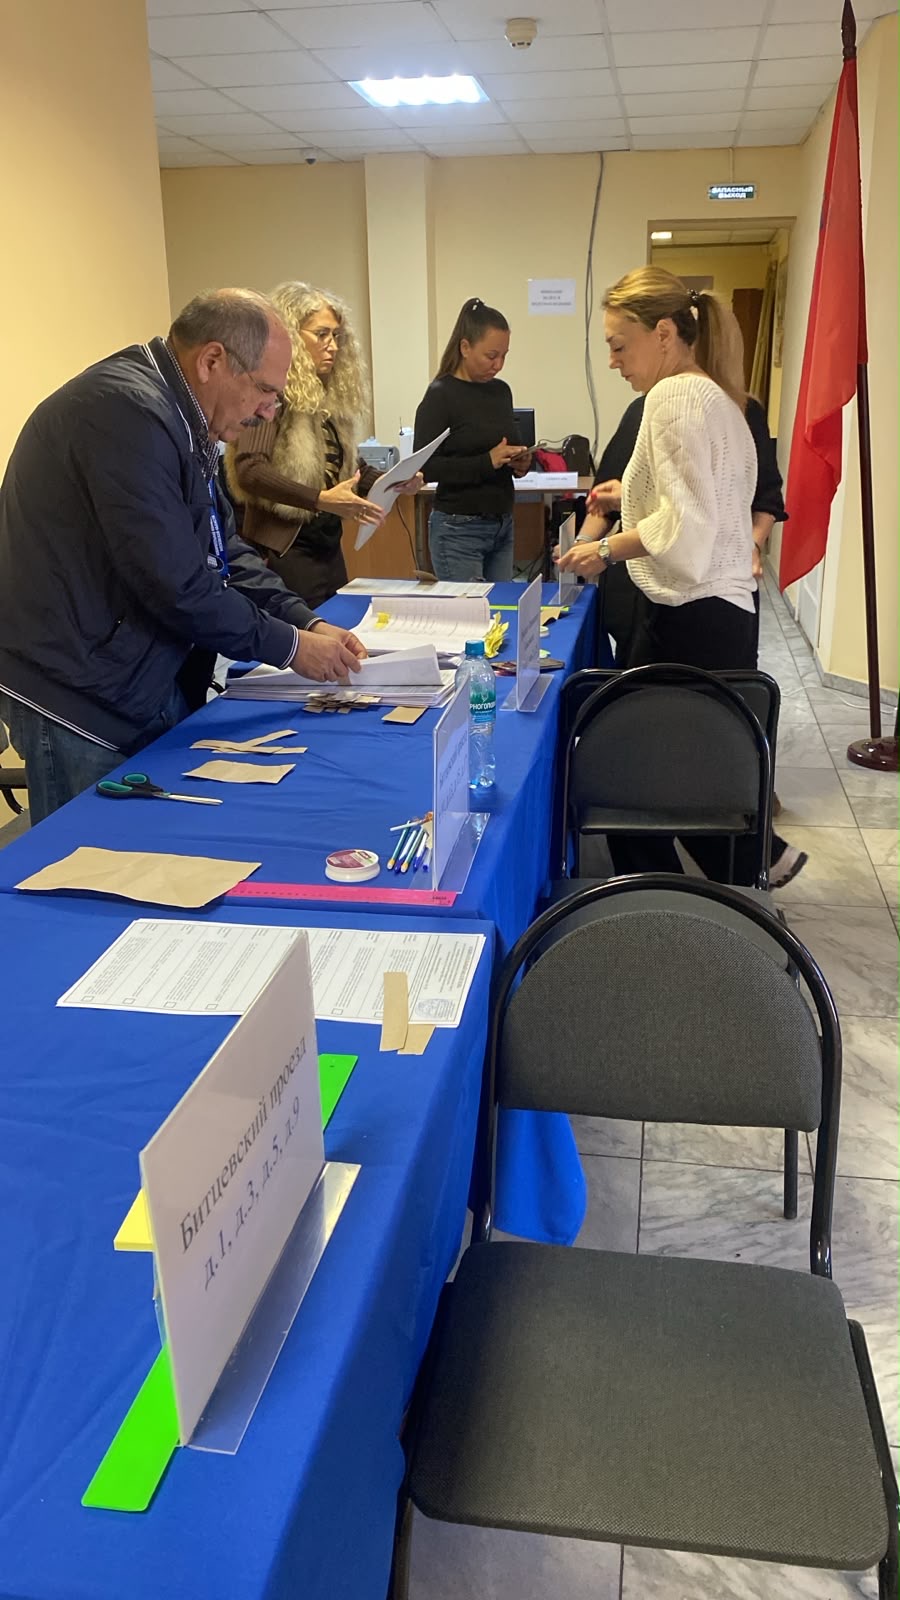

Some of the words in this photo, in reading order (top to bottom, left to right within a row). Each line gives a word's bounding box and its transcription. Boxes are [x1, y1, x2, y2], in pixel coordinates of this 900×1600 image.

[179, 1095, 268, 1255] Битцевский
[269, 1036, 307, 1112] проезд
[204, 1230, 232, 1291] д.1,
[235, 1180, 260, 1236] д.3,
[262, 1134, 283, 1186] д.5,
[285, 1096, 300, 1145] д.9
